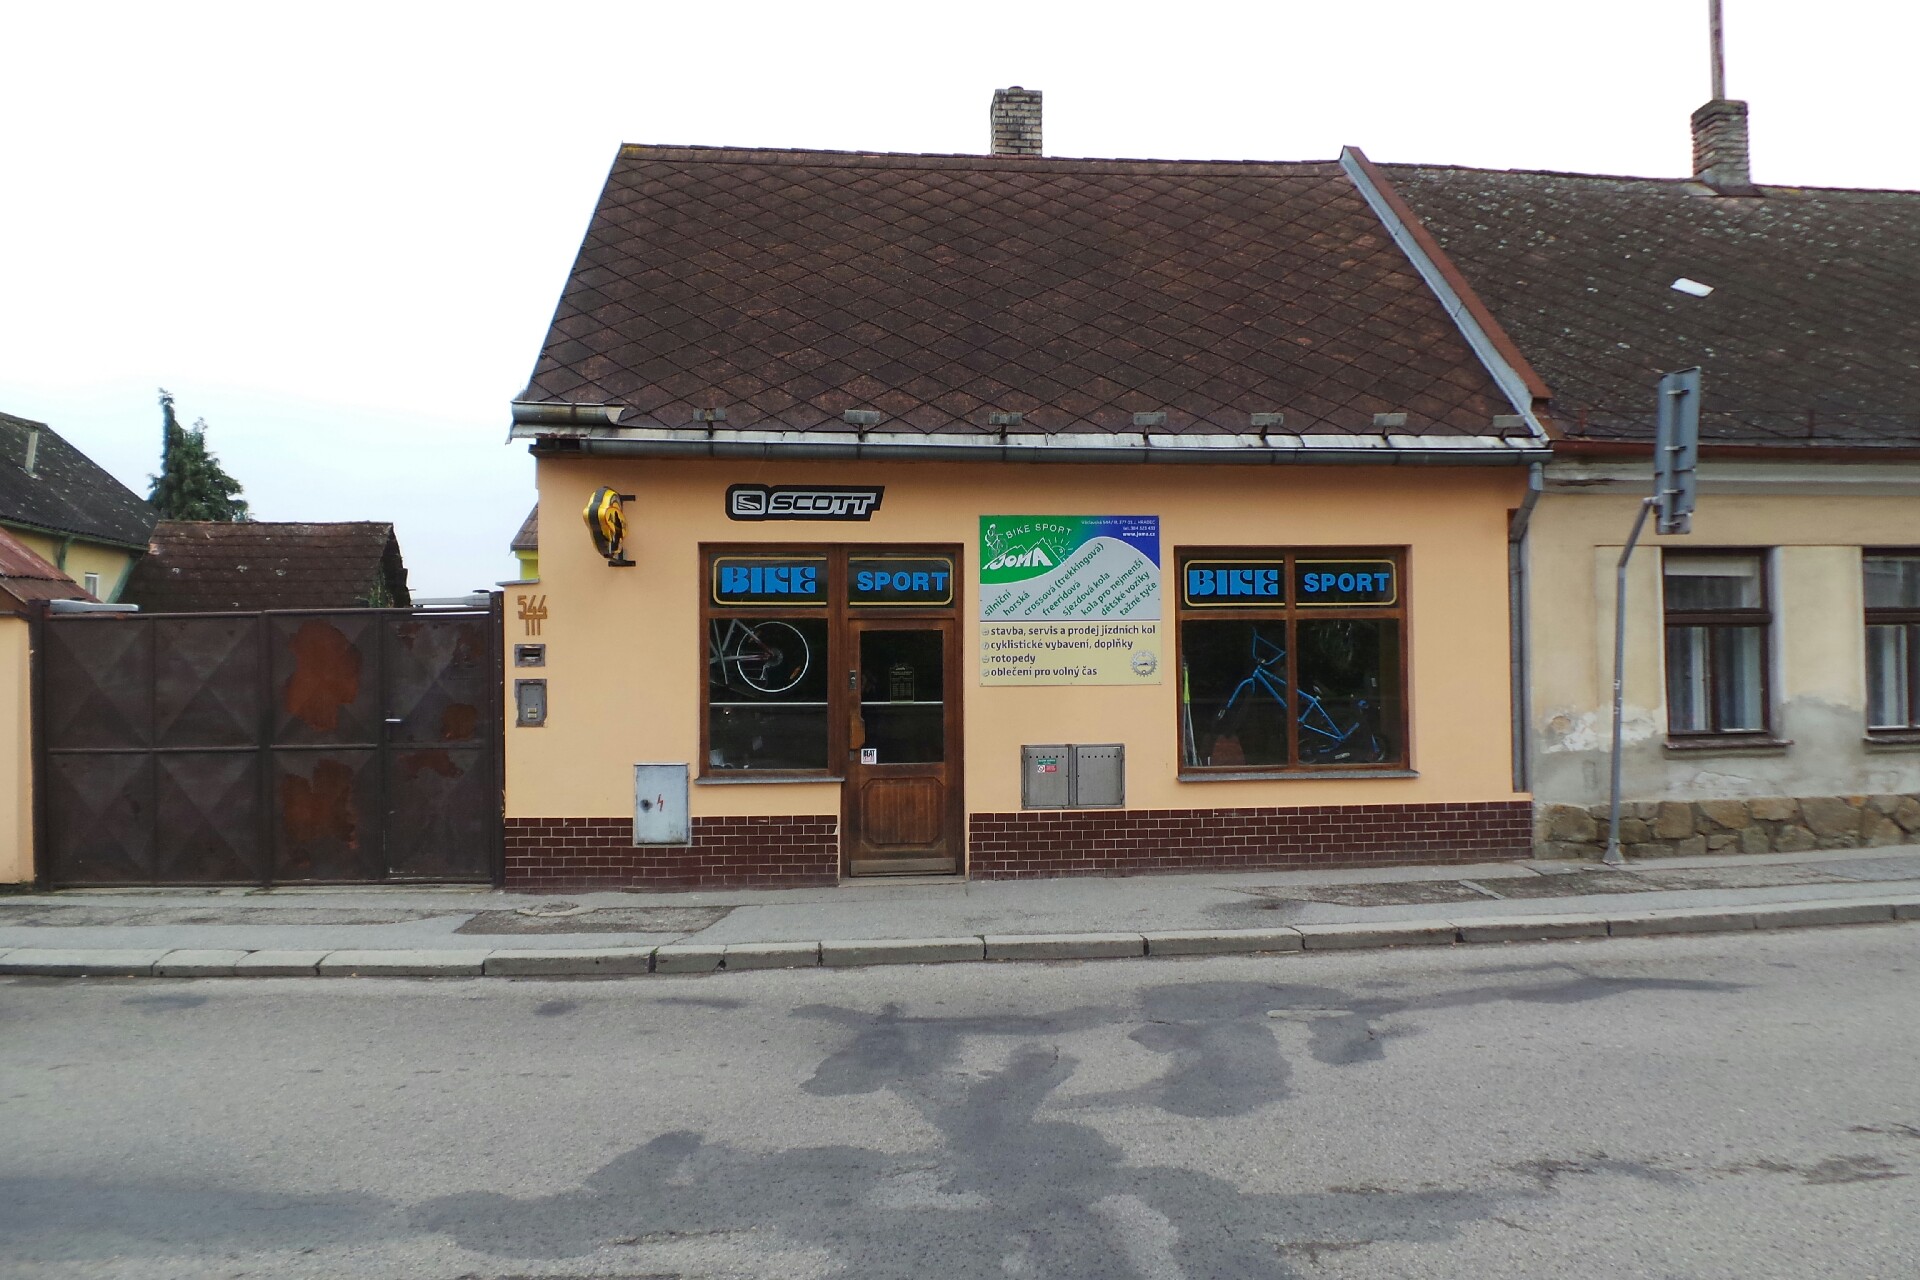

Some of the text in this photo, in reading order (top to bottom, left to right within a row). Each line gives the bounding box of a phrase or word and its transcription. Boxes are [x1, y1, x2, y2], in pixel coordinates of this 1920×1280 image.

[770, 494, 874, 512] SCOTT
[1006, 523, 1072, 538] BIKE SPORT
[989, 547, 1053, 570] JOMA
[721, 567, 948, 593] BIKE SPORT
[1024, 542, 1104, 616] crossová (trekkingová)
[1081, 558, 1144, 616] kola pro nejmenší
[1188, 569, 1390, 595] BIKE SPORT
[984, 589, 1012, 616] silniční
[1003, 591, 1030, 616] horská
[1042, 580, 1081, 616] freeridová
[1062, 571, 1111, 617] sjezdová kola
[1101, 570, 1151, 617] dětské vozíky
[1119, 581, 1158, 616] tažné tyče
[517, 594, 548, 619] 544
[990, 626, 1026, 637] stavba,
[1028, 625, 1058, 635] servis
[1067, 625, 1099, 637] prodej
[1099, 625, 1139, 636] jízdních
[1141, 625, 1156, 634] kol
[990, 638, 1133, 651] cyklistické vybavení, doplňky
[990, 653, 1036, 664] rotopedy
[990, 665, 1097, 678] oblečení pro volný čas
